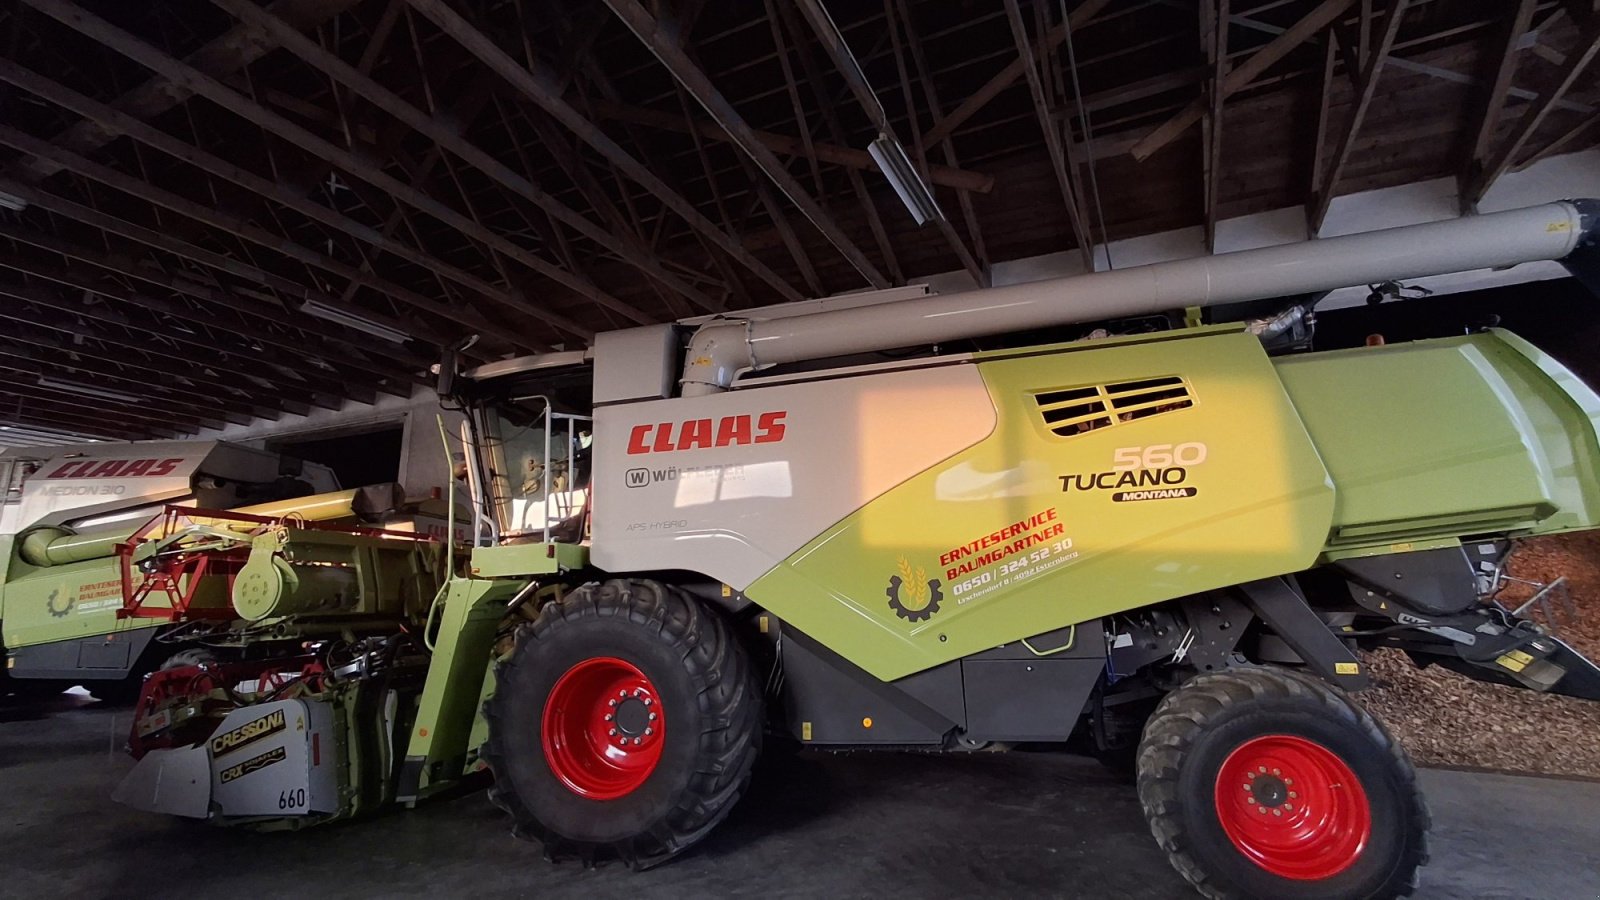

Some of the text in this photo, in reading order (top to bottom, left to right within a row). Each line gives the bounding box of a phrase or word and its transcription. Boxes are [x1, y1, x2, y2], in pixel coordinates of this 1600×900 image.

[627, 411, 787, 455] CLAAS
[47, 458, 184, 478] CLAAS
[1111, 442, 1208, 472] 560
[40, 485, 126, 496] MEDION 310
[1058, 467, 1187, 492] TUCANO
[1121, 488, 1188, 501] MONTANA
[626, 520, 688, 532] APS HYBRID
[939, 507, 1058, 567] ERNTESERVICE
[946, 522, 1065, 581] BAUMGARTNER
[953, 572, 991, 596] 0650
[1000, 556, 1029, 576] 324
[1030, 547, 1050, 563] 52
[1053, 538, 1073, 554] 30
[222, 764, 243, 781] CRX
[278, 788, 305, 809] 660
